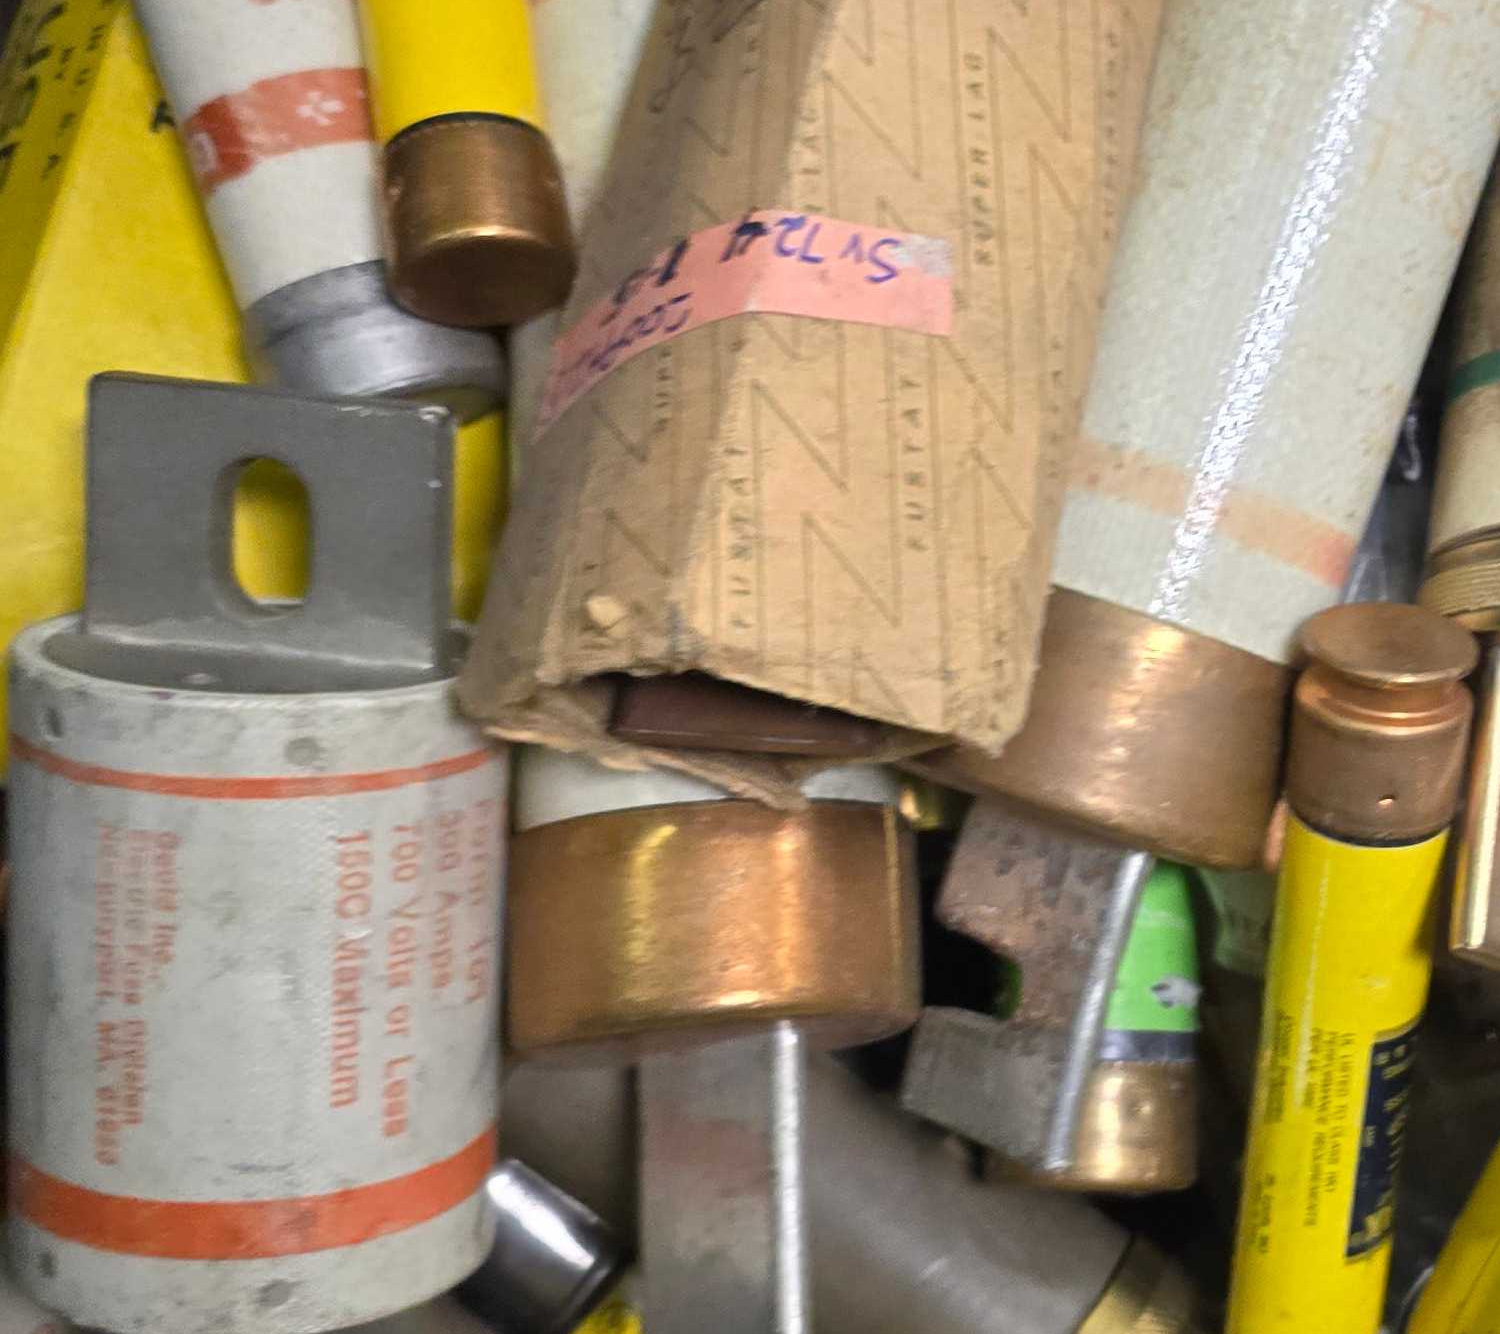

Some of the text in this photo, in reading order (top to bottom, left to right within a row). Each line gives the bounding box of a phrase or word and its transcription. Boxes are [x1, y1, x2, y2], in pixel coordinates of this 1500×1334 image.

[386, 895, 420, 988] Volts
[330, 933, 368, 1109] Maximum
[387, 1005, 411, 1037] or
[382, 1057, 413, 1138] Less
